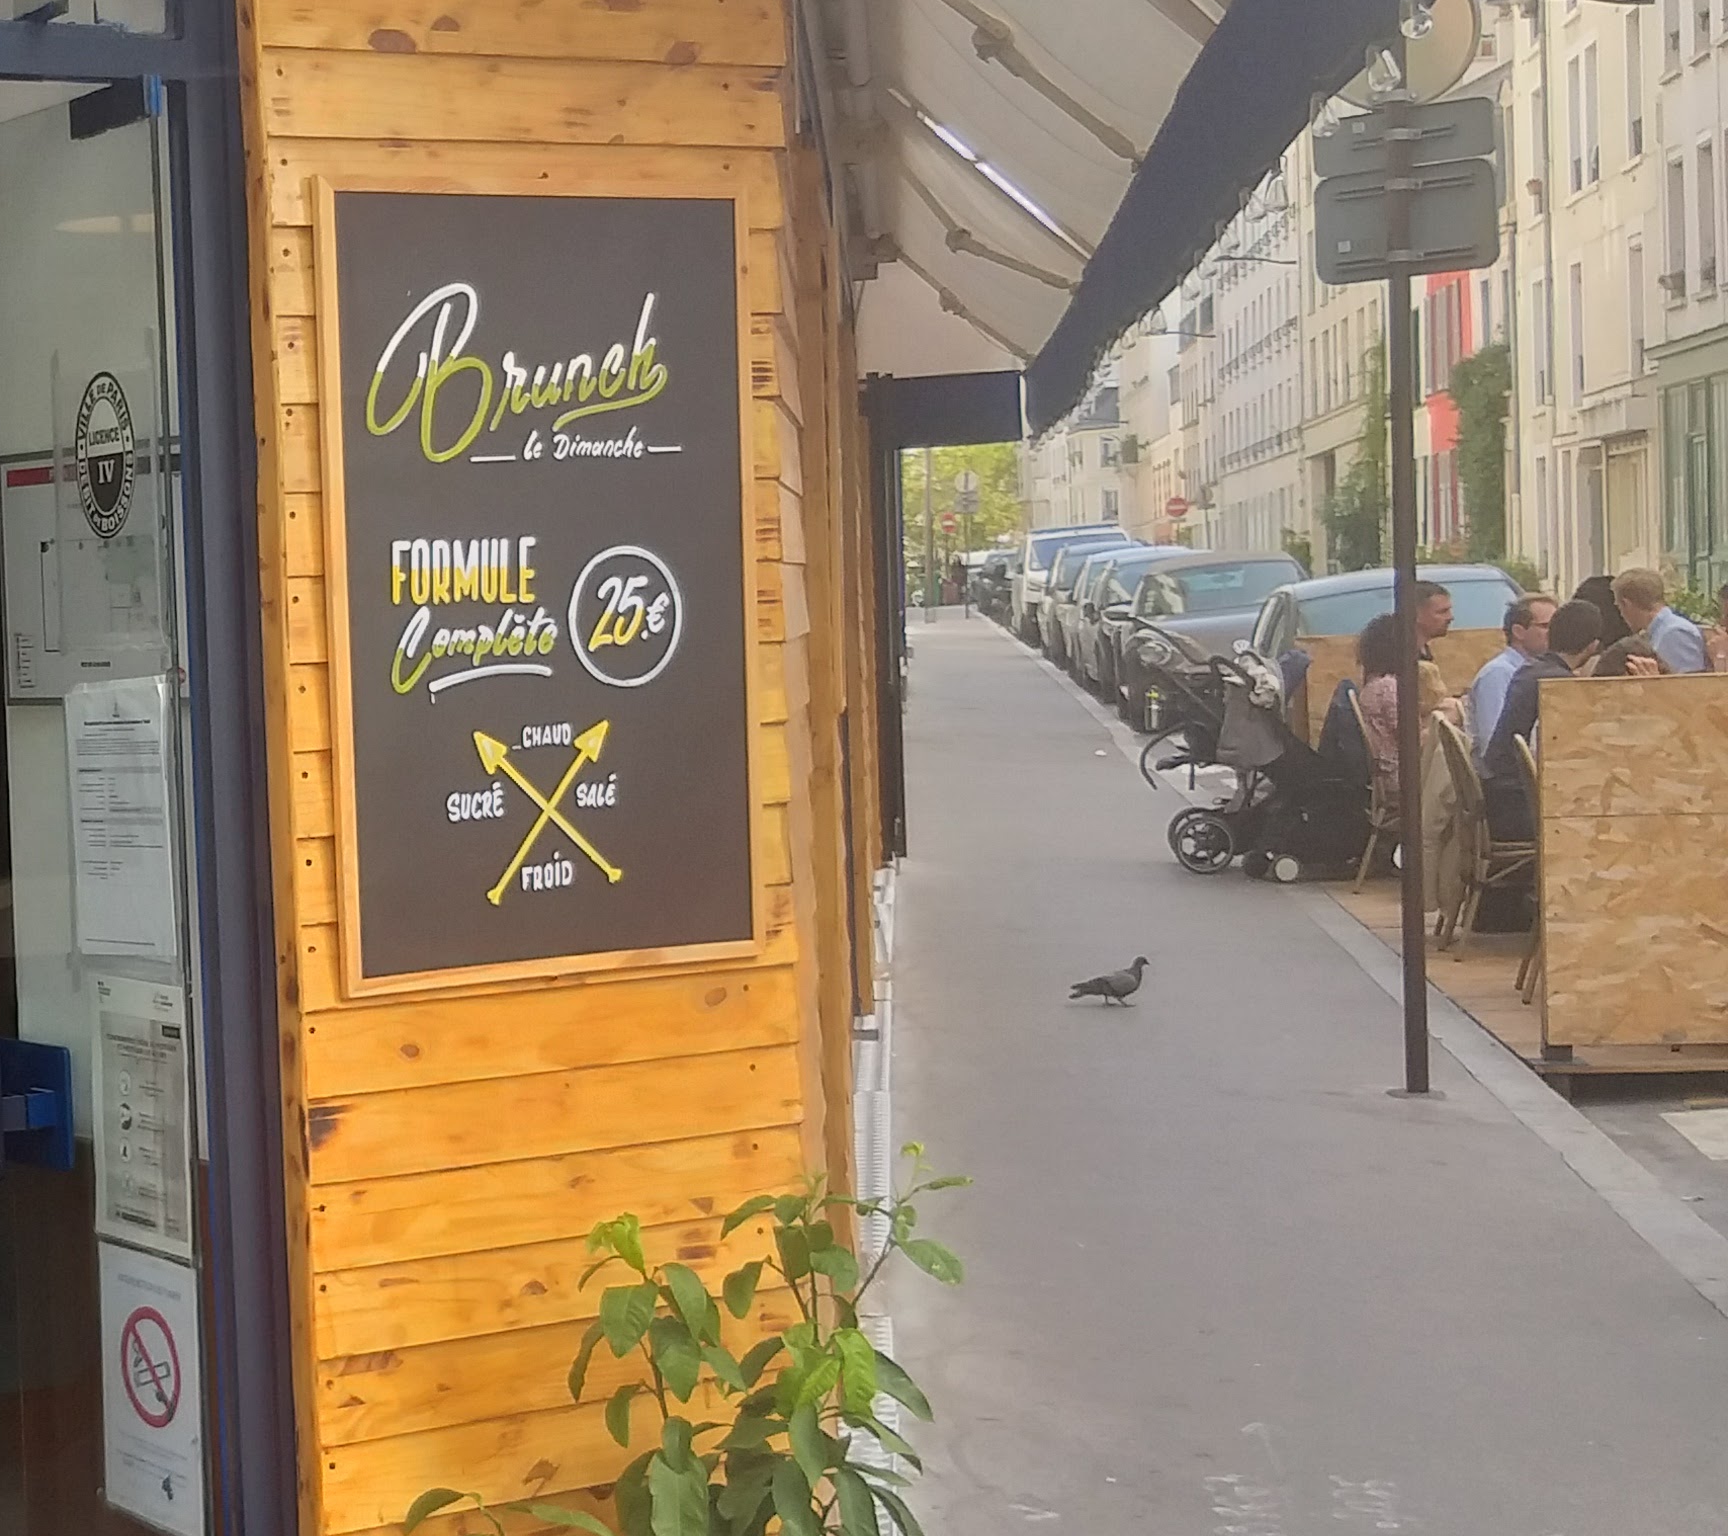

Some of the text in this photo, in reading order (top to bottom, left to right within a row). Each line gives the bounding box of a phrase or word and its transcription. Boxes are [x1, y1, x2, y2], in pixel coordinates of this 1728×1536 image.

[366, 282, 669, 463] Brunch
[106, 381, 130, 431] PARIS
[88, 427, 120, 447] LICENCE
[553, 426, 643, 459] Dimanche
[97, 459, 115, 484] IV
[390, 536, 537, 606] FORMULE
[522, 722, 572, 749] CHAUD
[446, 781, 505, 822] SUCRÉ
[575, 772, 618, 809] SALÉ
